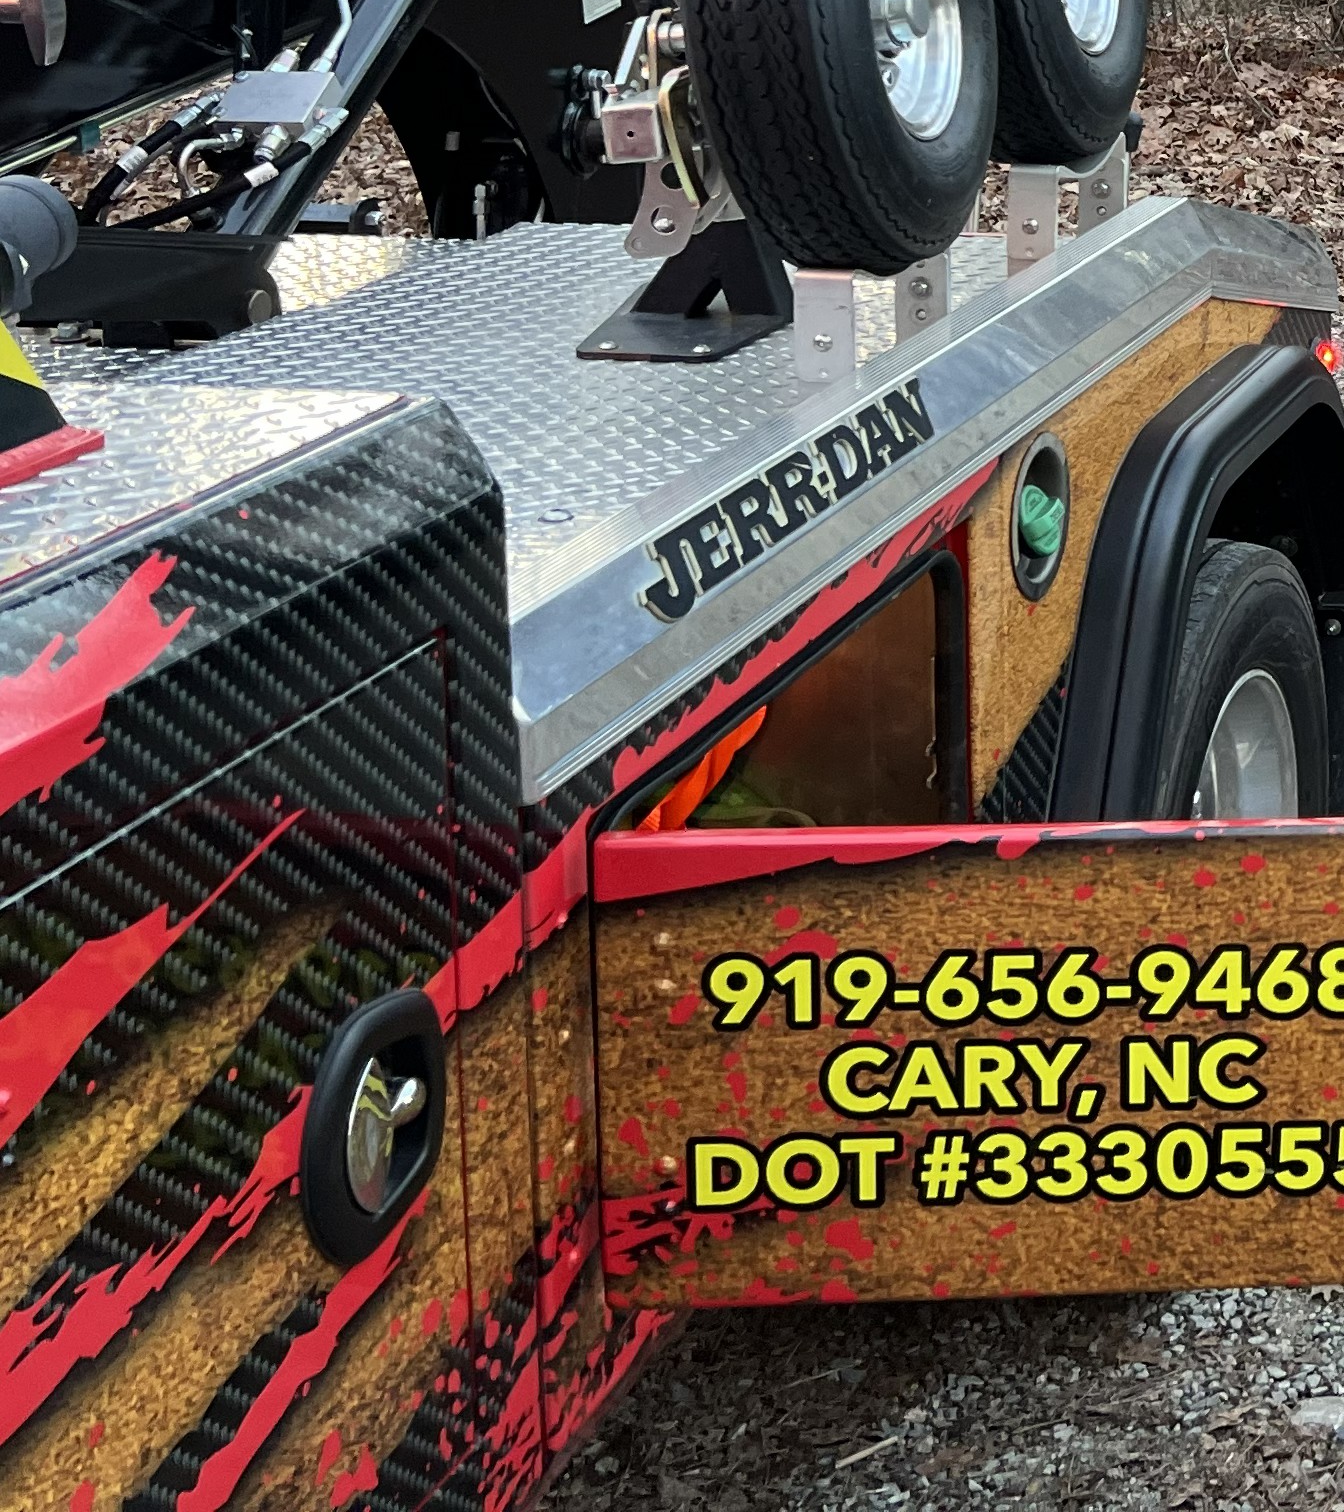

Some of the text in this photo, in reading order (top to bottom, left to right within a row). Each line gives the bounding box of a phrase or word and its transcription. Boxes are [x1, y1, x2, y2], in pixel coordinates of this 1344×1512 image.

[826, 1037, 1259, 1117] CARY, NC
[693, 1135, 897, 1207] DOT
